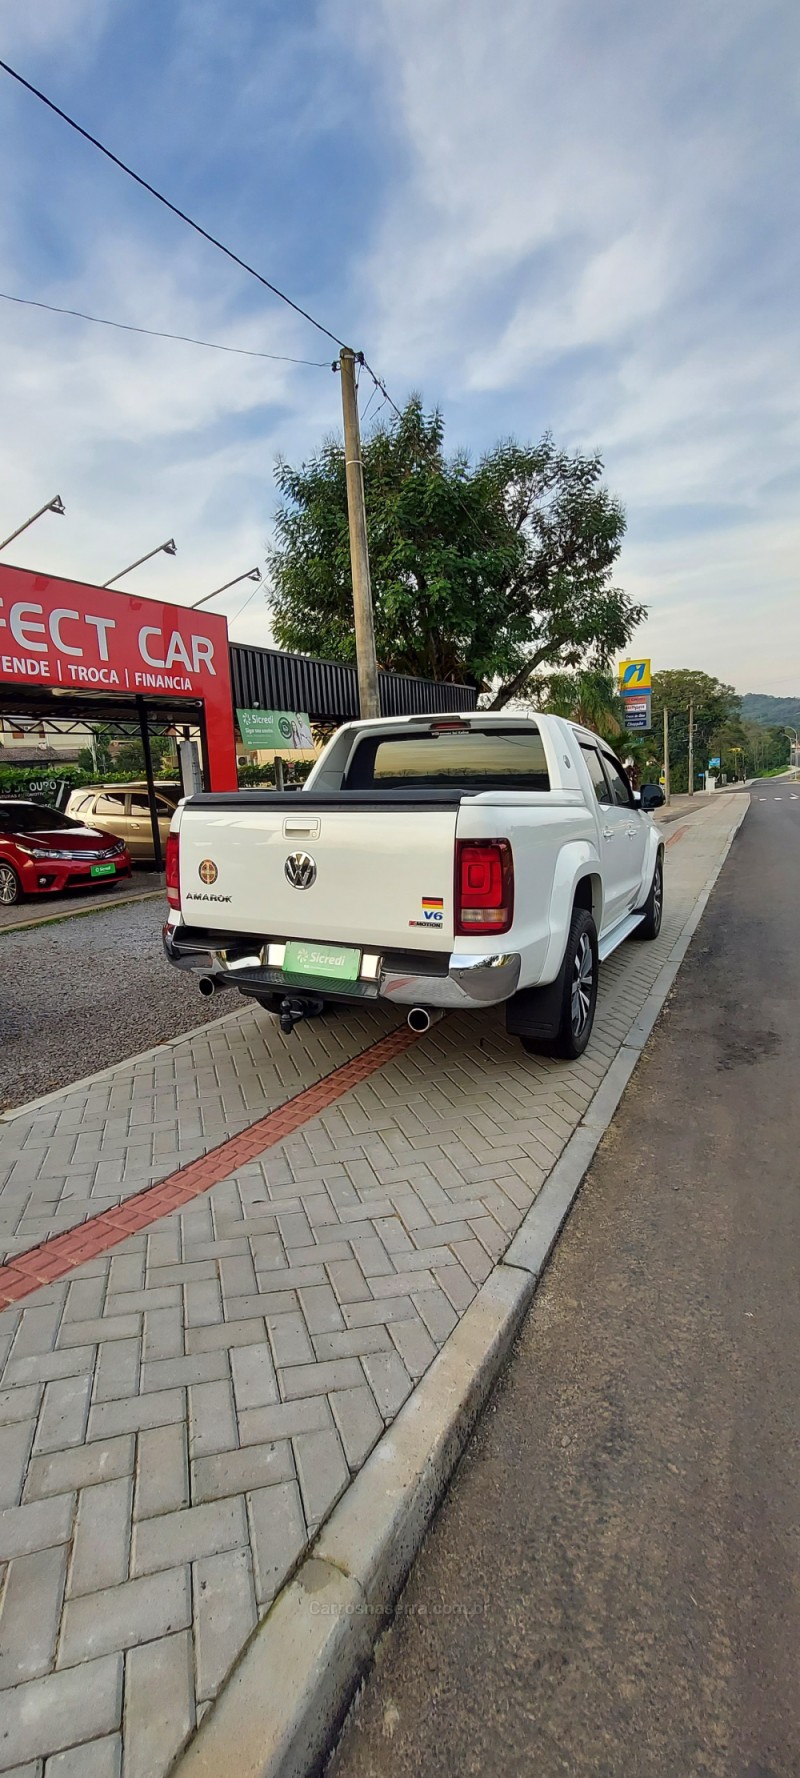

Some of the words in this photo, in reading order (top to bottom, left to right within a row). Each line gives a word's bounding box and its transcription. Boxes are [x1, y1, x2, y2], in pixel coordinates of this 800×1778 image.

[138, 626, 216, 675] CAR
[0, 655, 50, 677] ENDE
[68, 665, 119, 684] TROCA
[135, 672, 192, 691] FINANCIA
[252, 714, 274, 724] Sicredi
[185, 892, 232, 903] AMAROK
[424, 911, 443, 920] V6
[310, 951, 346, 966] Sicredi
